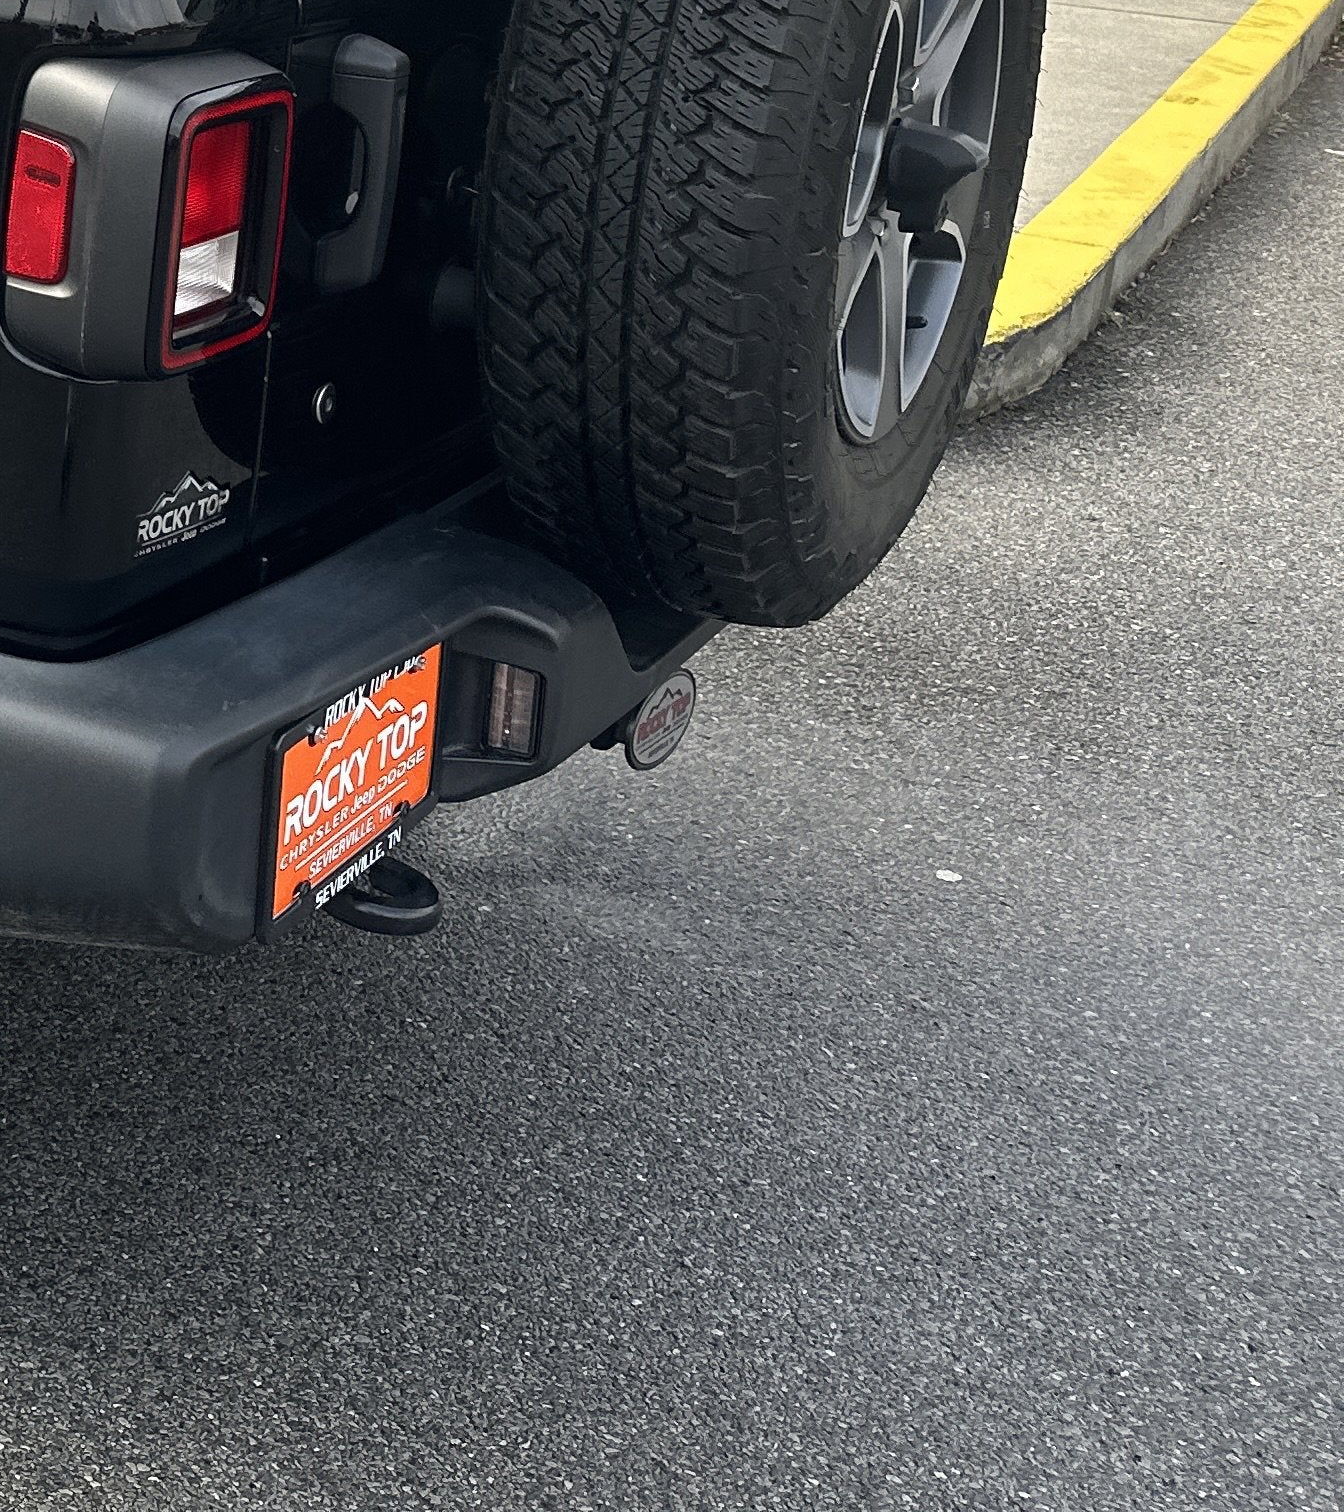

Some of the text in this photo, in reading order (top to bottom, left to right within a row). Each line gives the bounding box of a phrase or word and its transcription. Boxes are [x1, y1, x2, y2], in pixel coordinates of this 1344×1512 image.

[137, 501, 196, 543] ROCKY
[198, 488, 230, 521] TOP
[283, 700, 429, 846] ROCKY TOP
[279, 746, 426, 871] CHRYSLER Jeep DODGE
[378, 801, 394, 824] TN
[387, 825, 402, 850] TN
